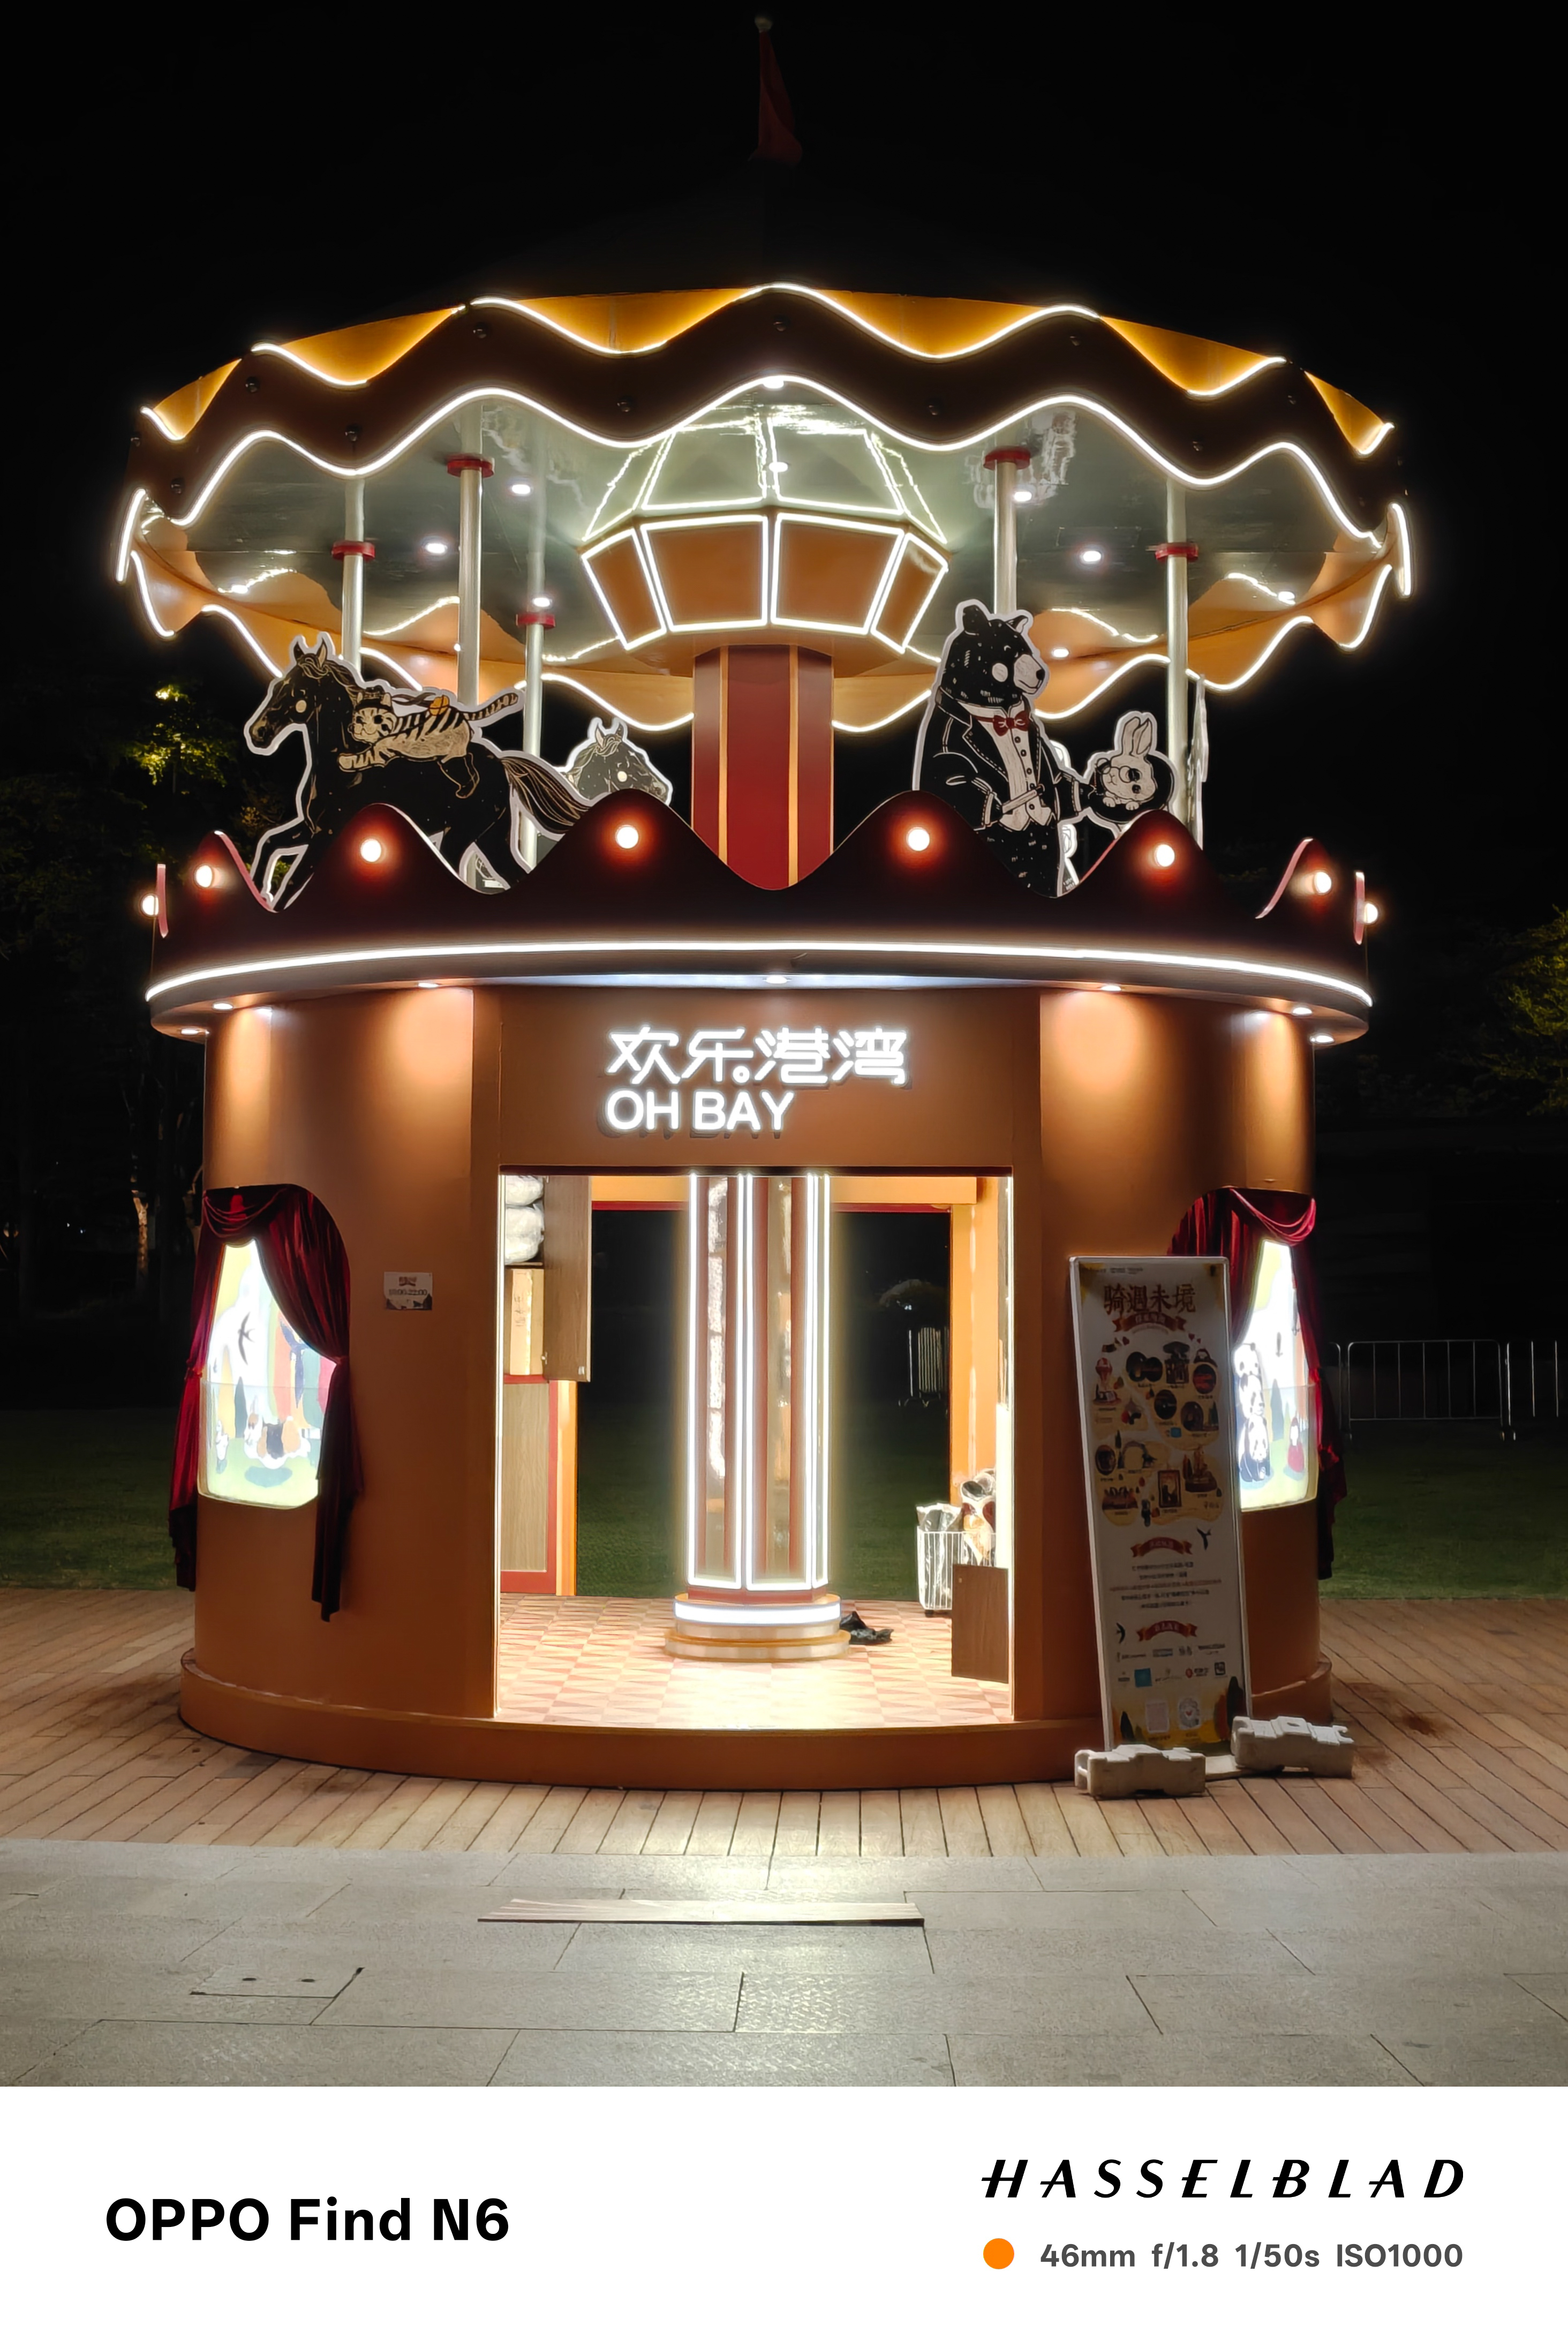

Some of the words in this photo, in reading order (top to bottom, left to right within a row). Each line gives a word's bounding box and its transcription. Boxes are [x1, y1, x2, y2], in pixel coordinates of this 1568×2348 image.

[605, 1025, 908, 1086] 欢乐港湾
[605, 1089, 680, 1131] OH
[692, 1089, 795, 1131] BAY
